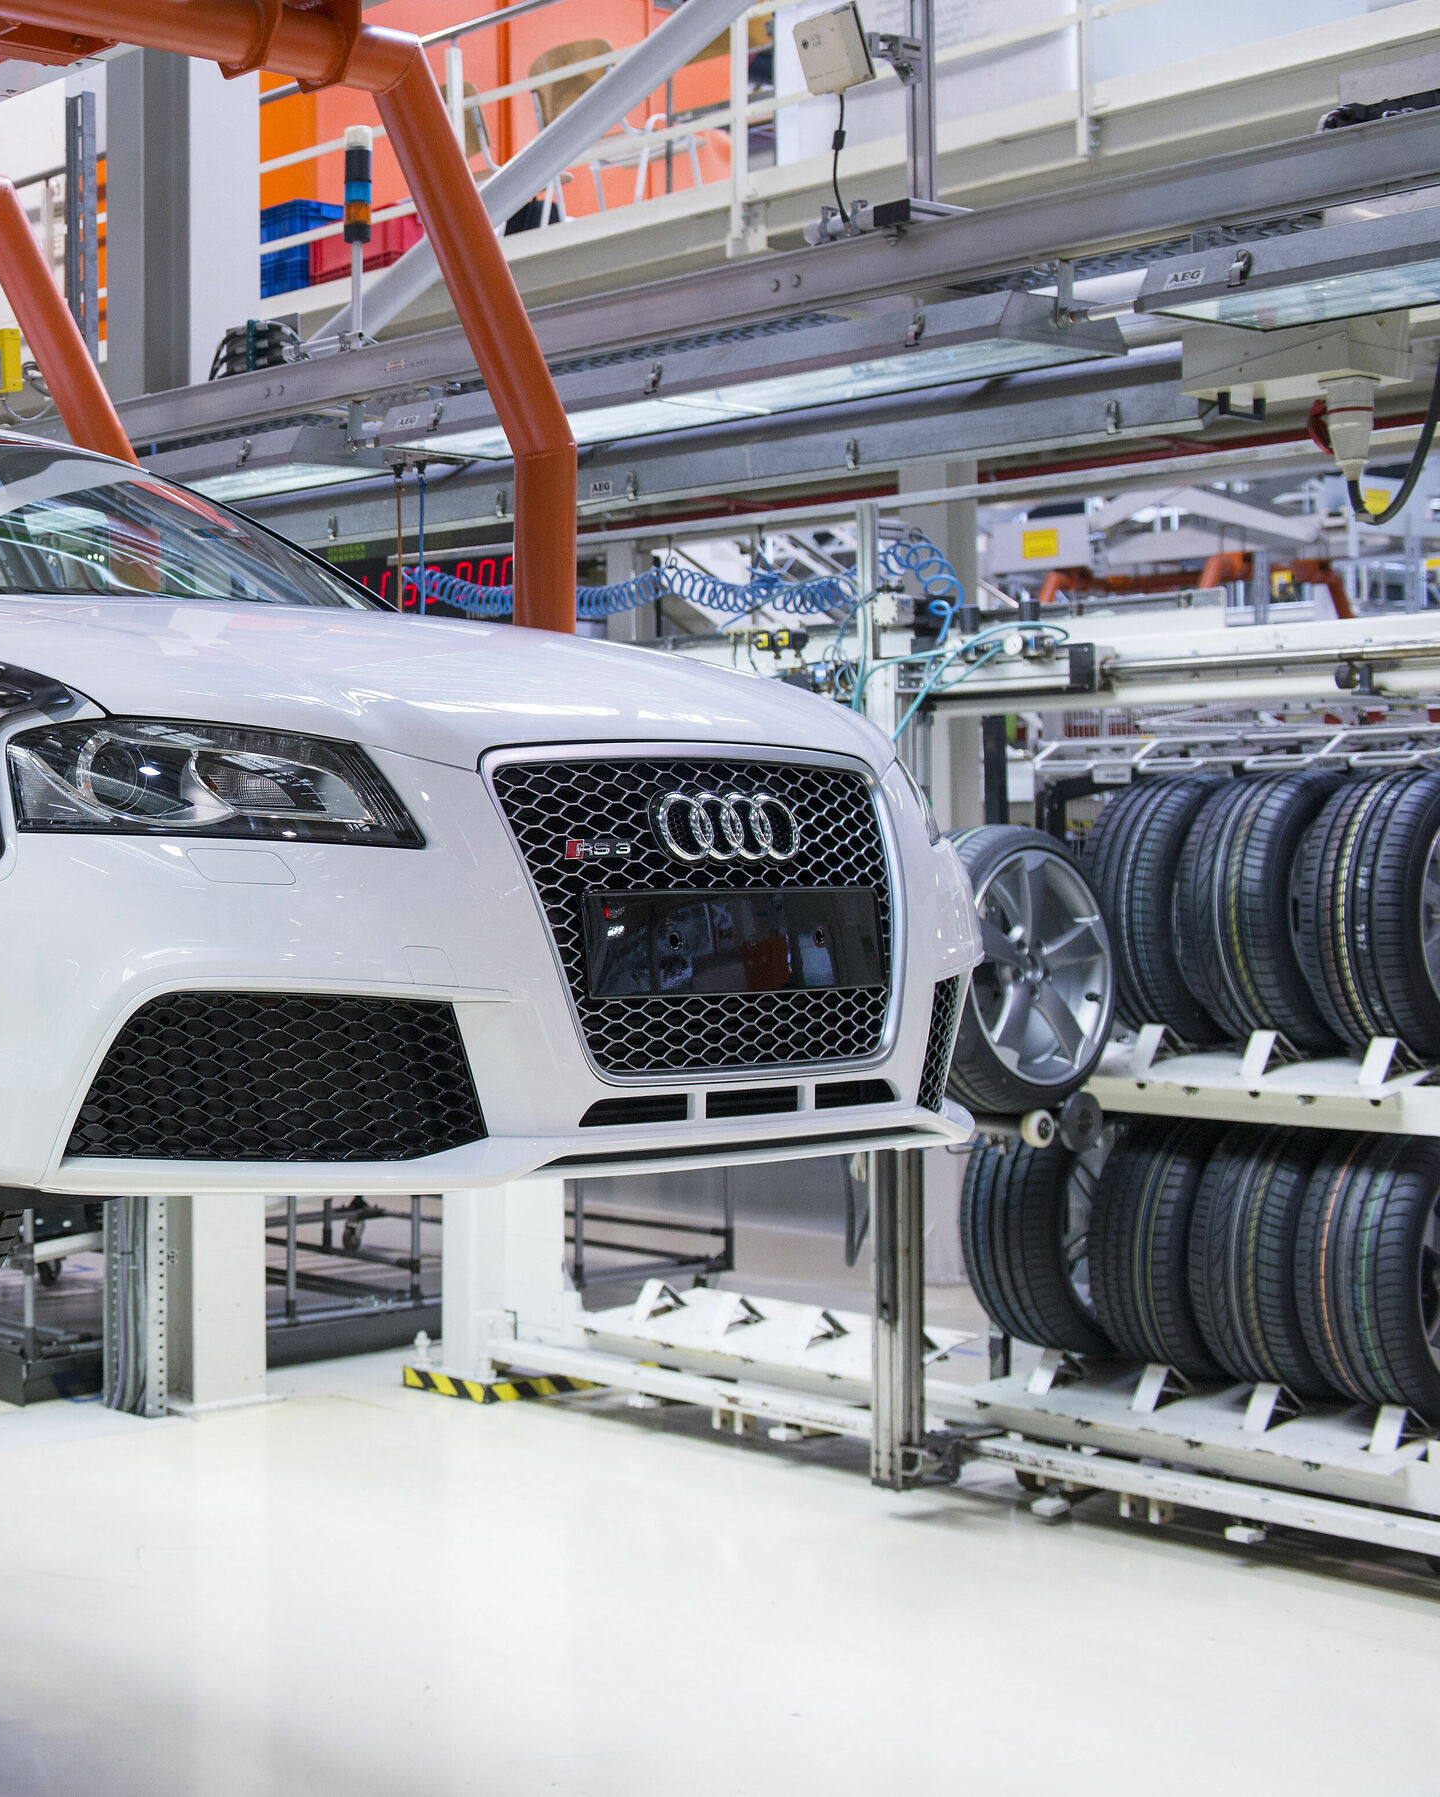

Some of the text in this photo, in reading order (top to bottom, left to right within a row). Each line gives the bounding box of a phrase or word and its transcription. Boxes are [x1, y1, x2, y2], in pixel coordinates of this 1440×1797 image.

[1169, 270, 1201, 284] AEG
[400, 416, 417, 425] AEG
[592, 481, 610, 491] AEG
[576, 842, 631, 856] RS 3
